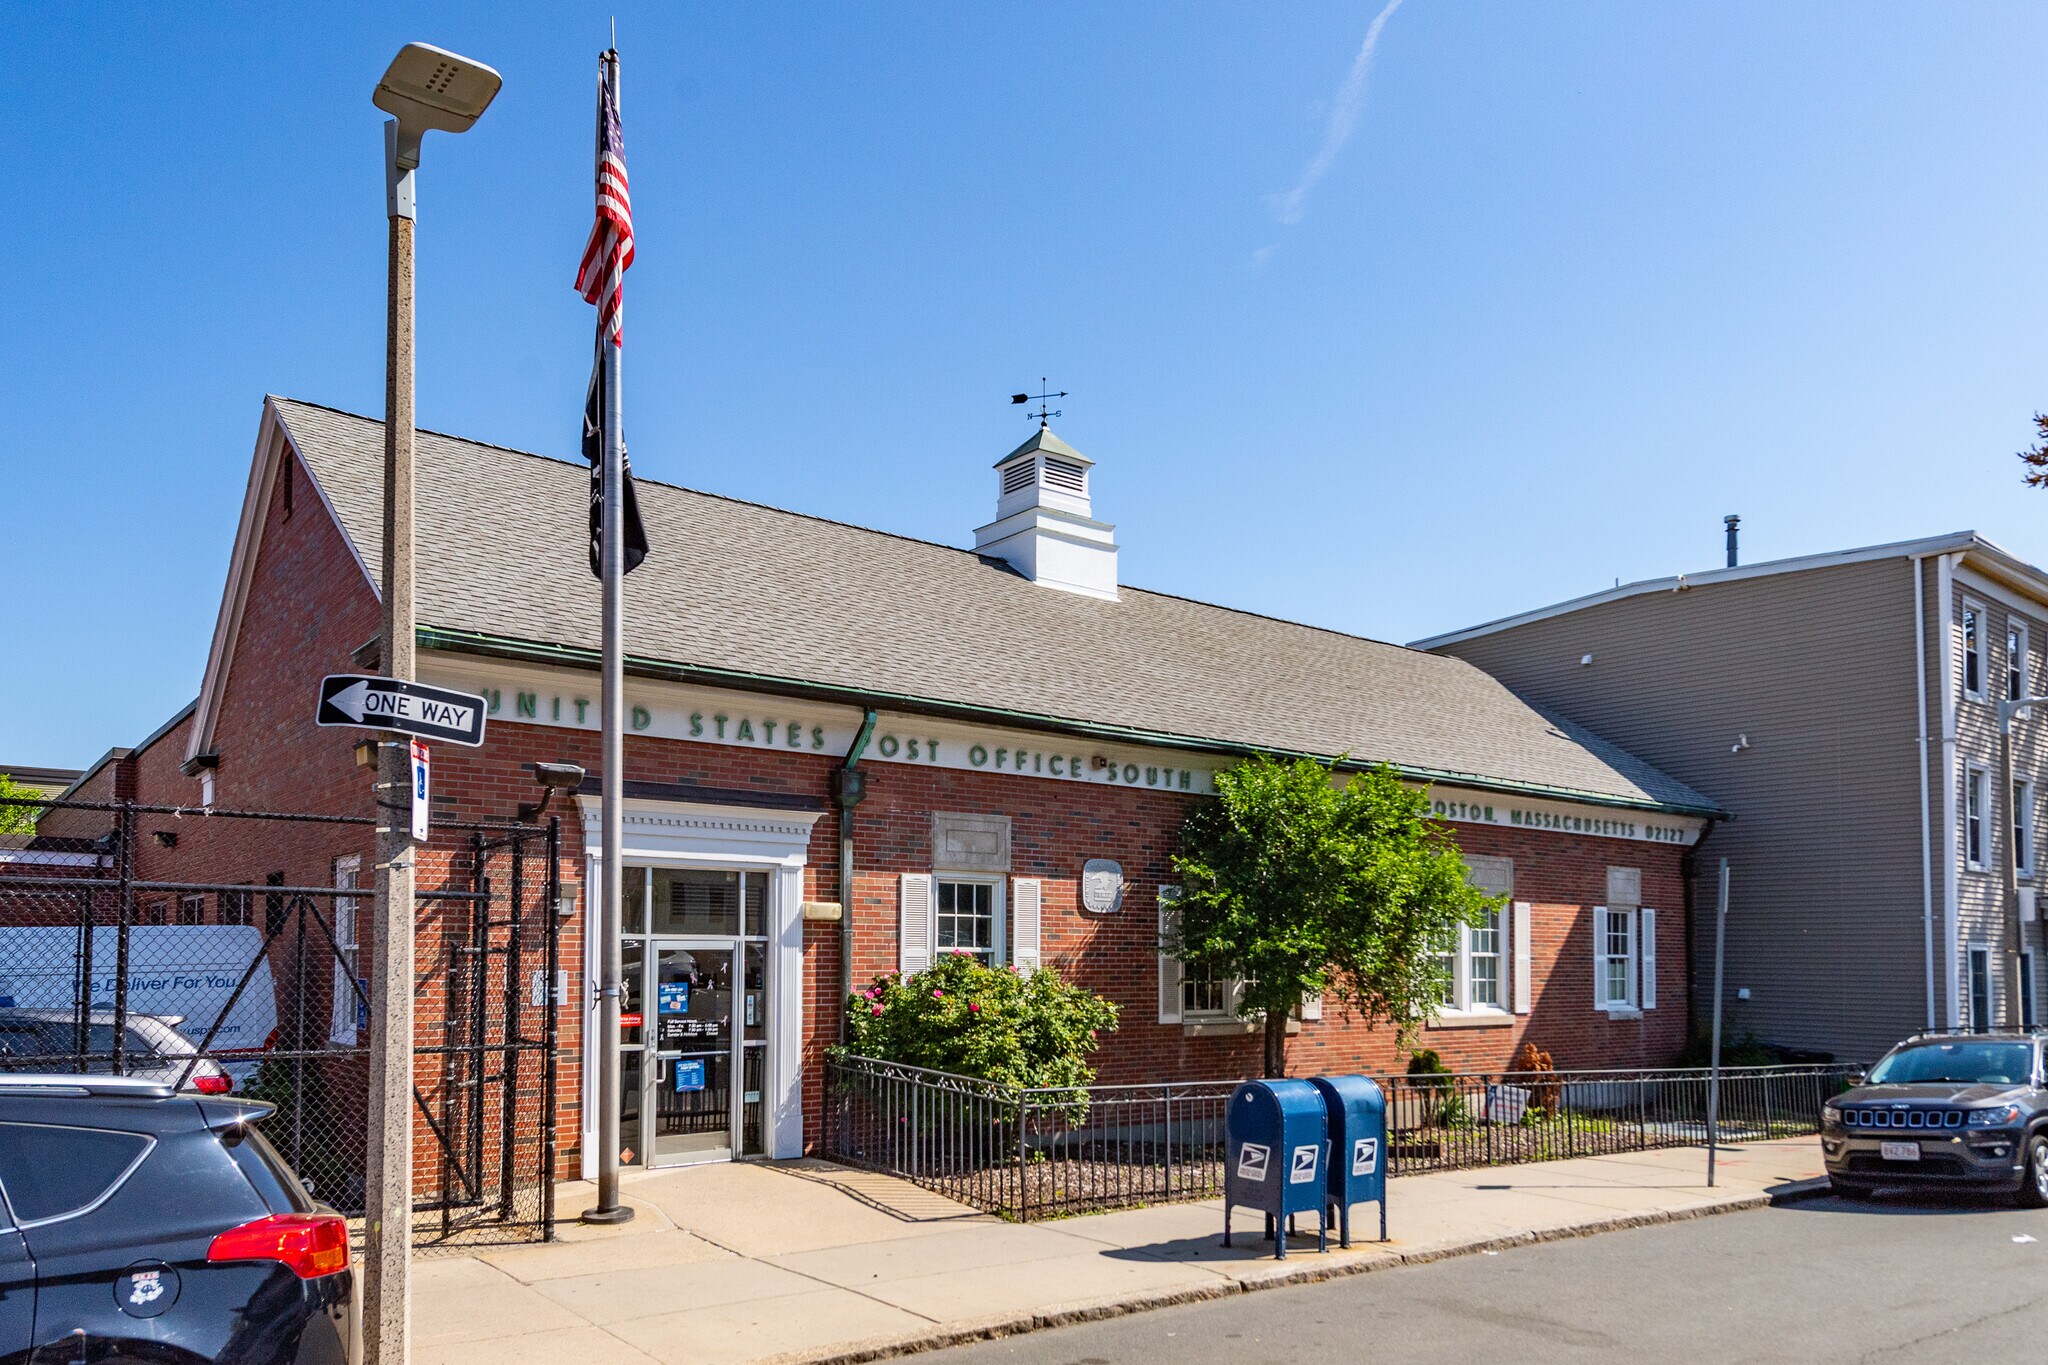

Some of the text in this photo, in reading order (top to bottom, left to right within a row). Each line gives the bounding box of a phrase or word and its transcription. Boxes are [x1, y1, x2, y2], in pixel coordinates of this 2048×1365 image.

[1027, 410, 1062, 420] N S
[365, 692, 468, 727] ONE WAY
[482, 687, 651, 732] UNITD
[691, 712, 826, 751] STATES
[863, 734, 941, 763] OST
[969, 744, 1083, 778] OFFICE
[1107, 761, 1192, 790] SOUTH
[1510, 808, 1636, 838] MASSACHUSETTS
[1645, 824, 1685, 843] 02127
[172, 976, 203, 990] For
